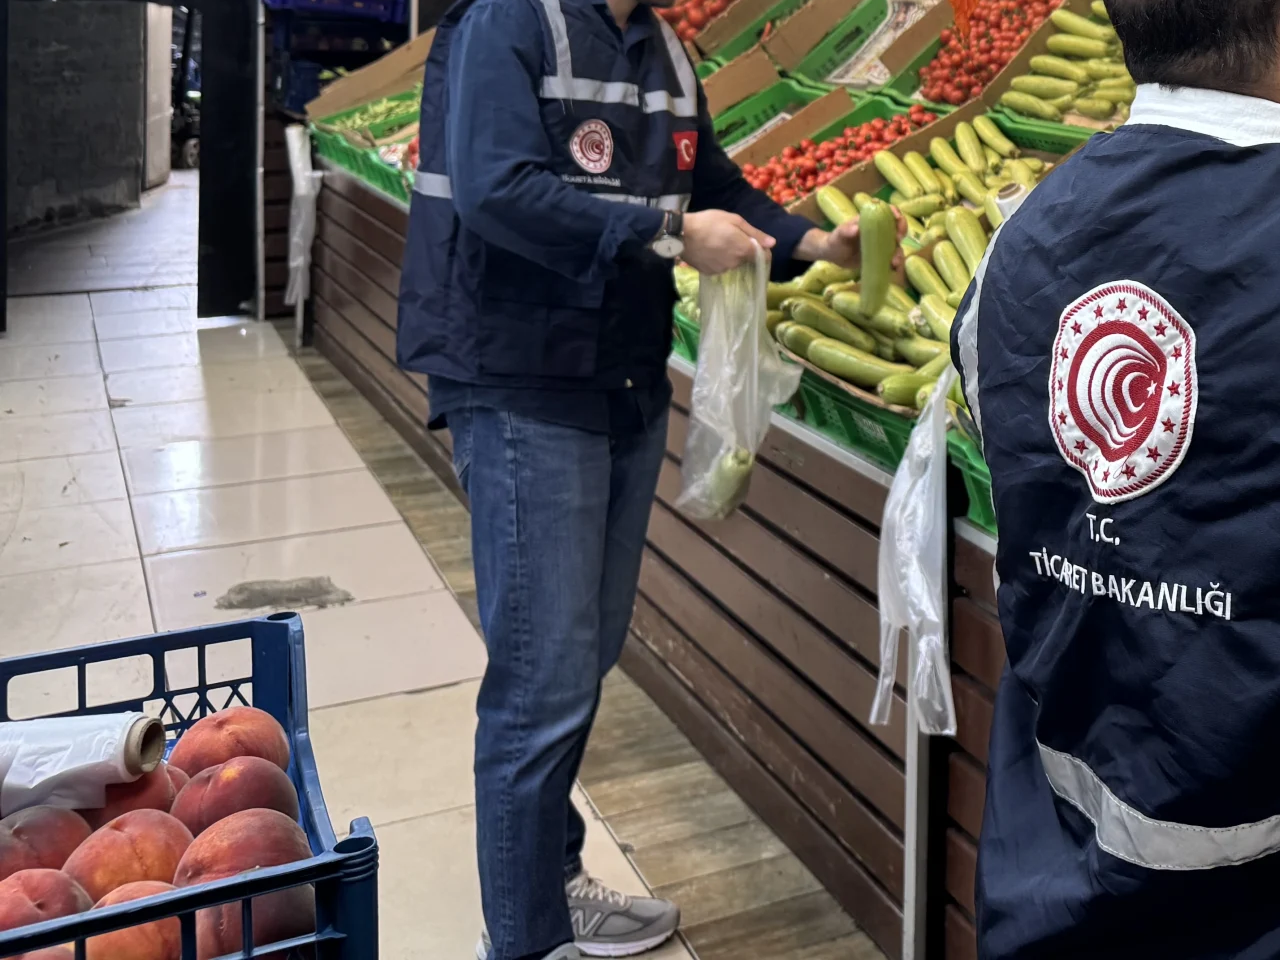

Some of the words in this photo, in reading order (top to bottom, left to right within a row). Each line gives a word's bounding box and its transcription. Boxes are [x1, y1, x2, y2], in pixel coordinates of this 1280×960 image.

[1086, 512, 1120, 546] T.C.
[1029, 546, 1088, 594] TİCARET
[1091, 571, 1232, 621] BAKANLIĞI
